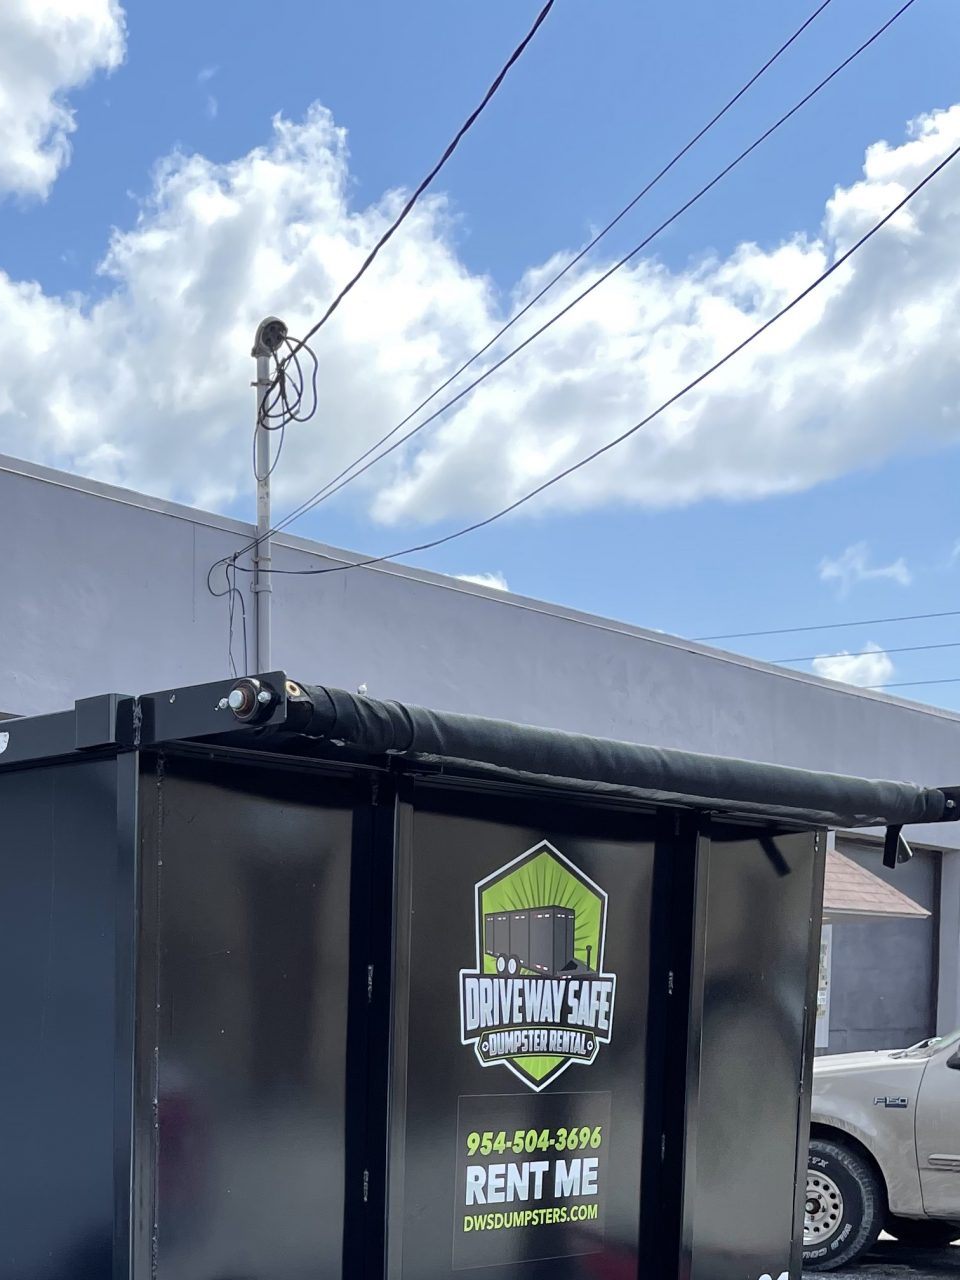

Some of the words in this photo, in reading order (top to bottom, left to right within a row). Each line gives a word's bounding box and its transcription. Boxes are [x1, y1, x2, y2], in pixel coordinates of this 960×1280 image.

[465, 977, 566, 1031] DRIVEWAY
[567, 980, 613, 1030] SAFE
[488, 1029, 548, 1056] DUMPSTER
[549, 1030, 587, 1055] RENTAL
[466, 1126, 602, 1156] 954-504-3696
[465, 1160, 549, 1206] RENT
[554, 1157, 599, 1198] ME
[463, 1204, 598, 1232] DWSDUMPSTERS.COM
